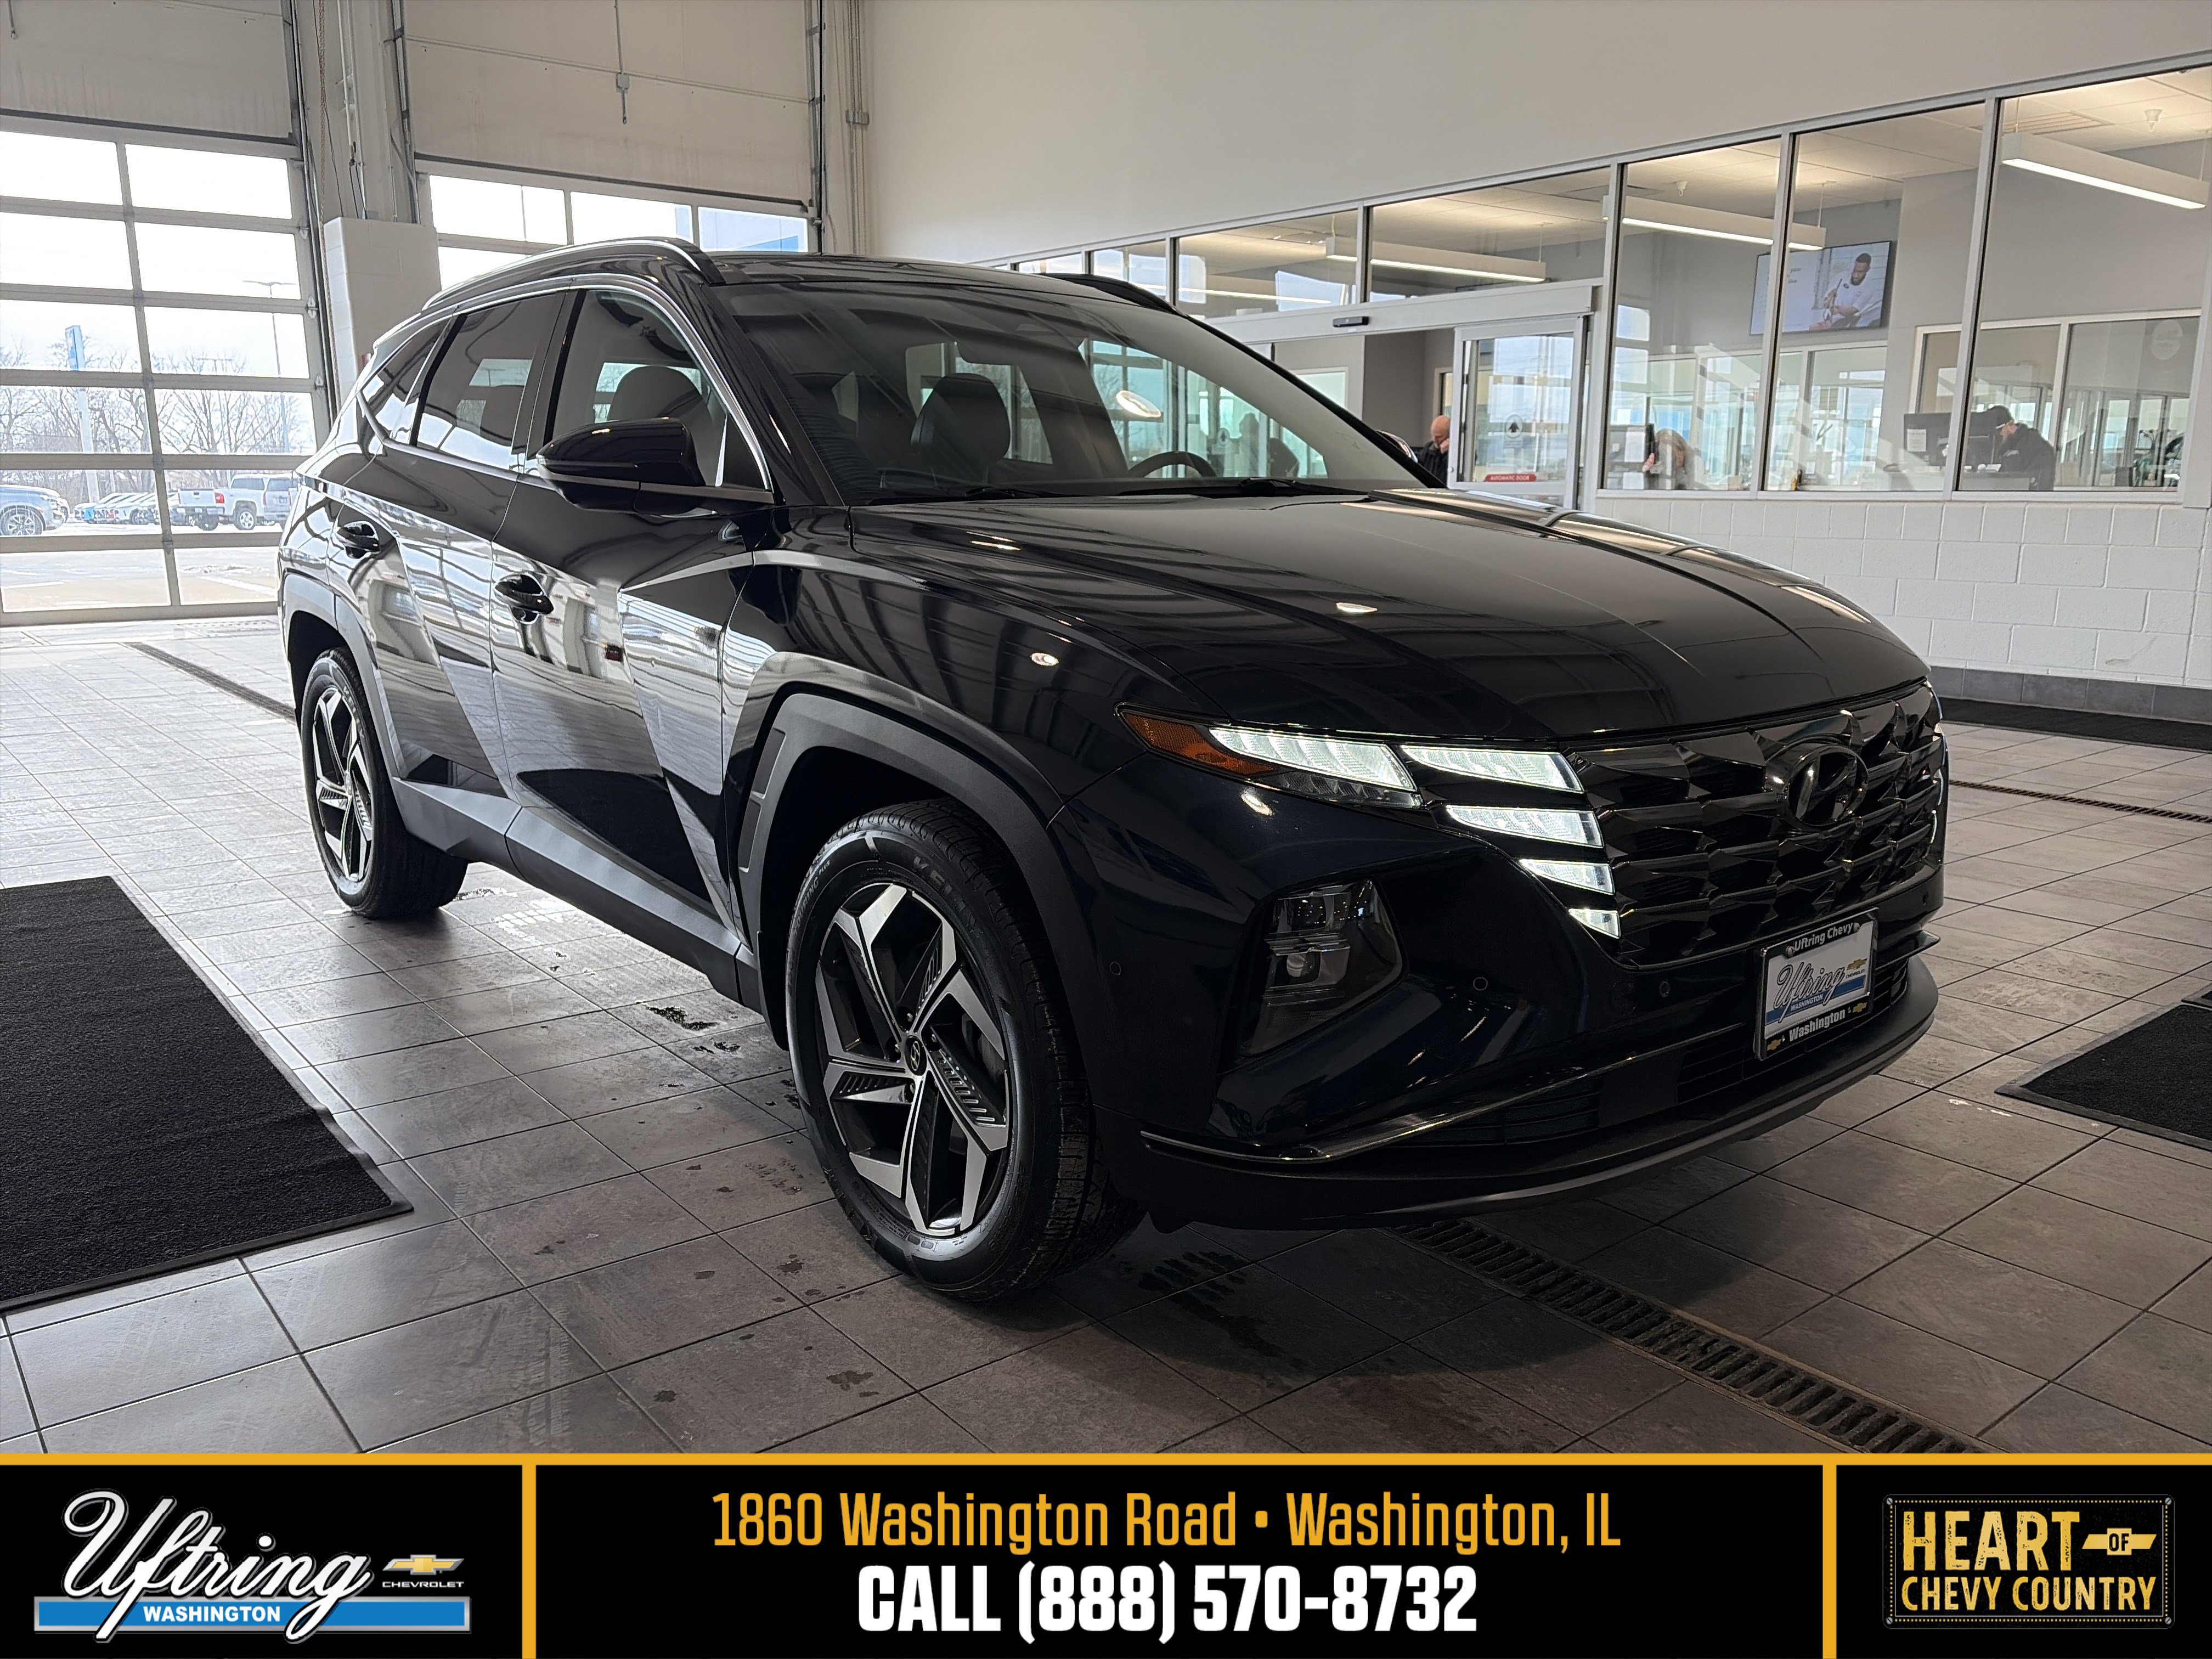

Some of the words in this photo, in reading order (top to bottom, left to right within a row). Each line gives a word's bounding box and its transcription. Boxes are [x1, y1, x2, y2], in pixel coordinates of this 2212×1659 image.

[1795, 933, 1826, 952] Uftring
[1827, 922, 1853, 939] Chevy
[1774, 961, 1845, 1024] Uftring
[1791, 994, 1823, 1012] WASHINGTON
[1789, 1009, 1846, 1042] Washington
